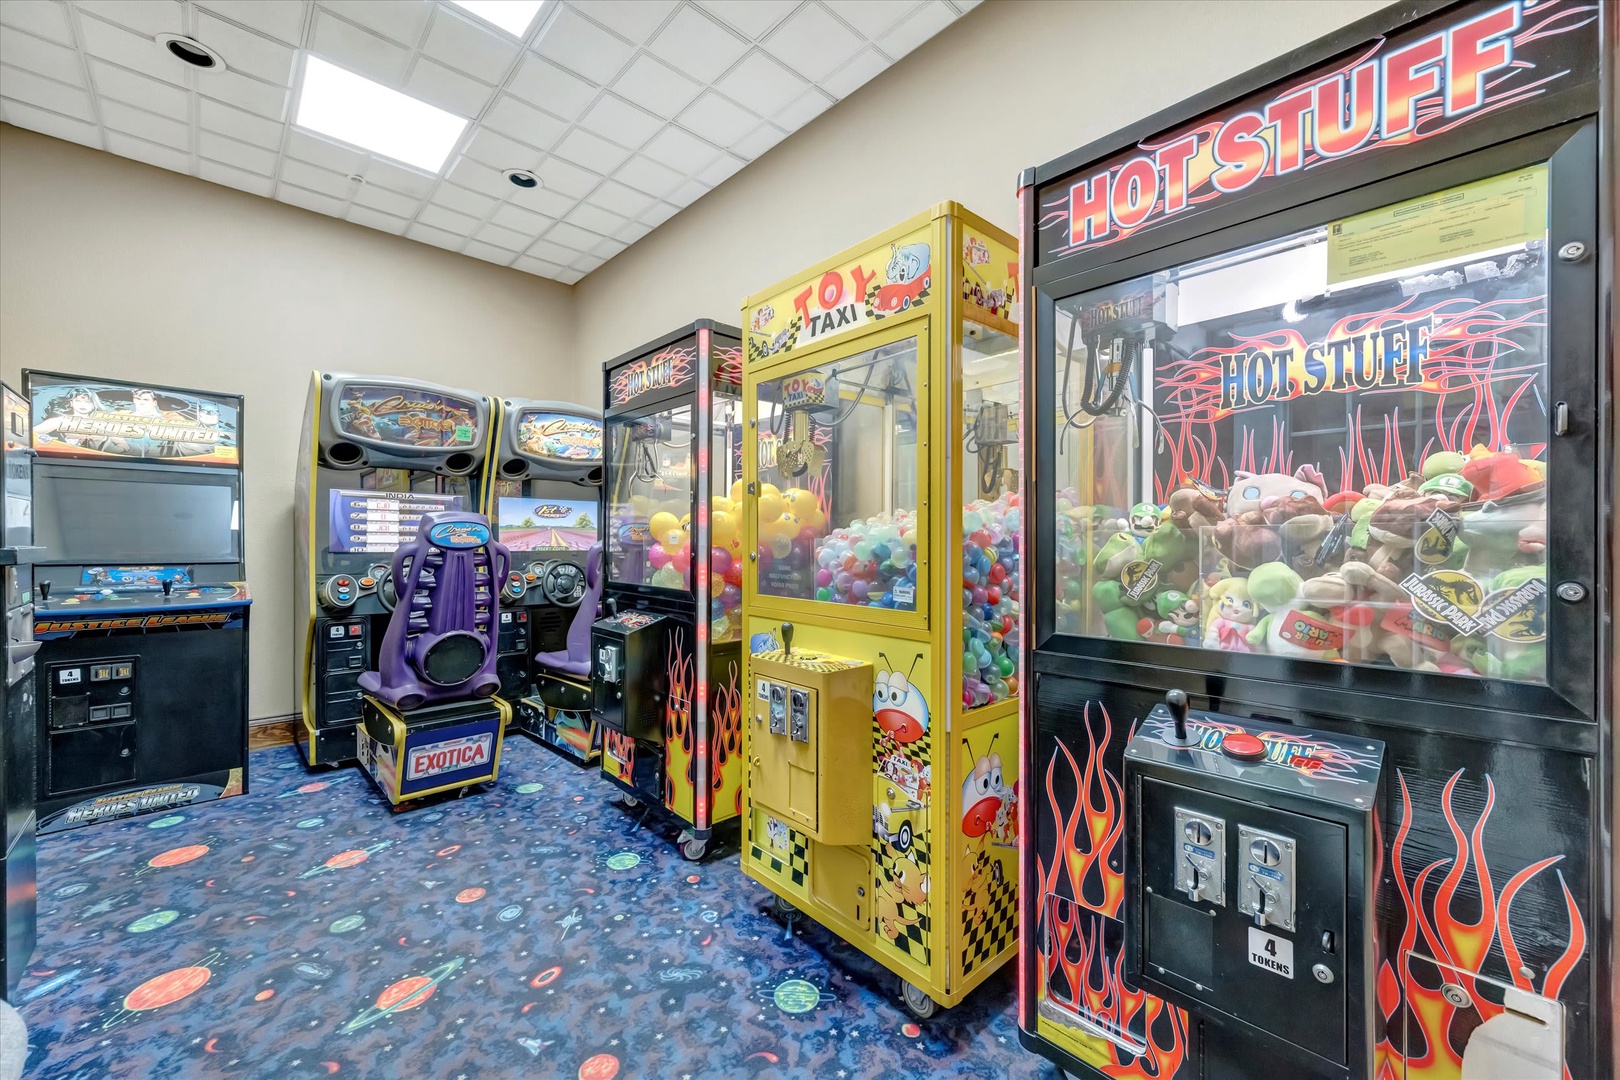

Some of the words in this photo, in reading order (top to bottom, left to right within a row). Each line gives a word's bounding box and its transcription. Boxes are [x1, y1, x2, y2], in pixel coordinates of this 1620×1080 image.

[1066, 134, 1200, 247] HOT
[1211, 2, 1525, 195] STUFF
[793, 264, 877, 329] TOY
[808, 303, 858, 338] TAXI
[1090, 307, 1110, 328] HOT
[1220, 349, 1294, 411] HOT
[1303, 312, 1434, 396] STUFF
[626, 370, 645, 398] HOT
[646, 356, 676, 389] STUFF
[784, 378, 809, 397] TOY
[789, 392, 804, 402] TAXI
[58, 415, 148, 438] HEROES
[148, 424, 220, 444] UNITED
[758, 440, 773, 468] OT
[538, 506, 558, 515] 1st
[1402, 577, 1448, 611] JURASSIC
[1440, 606, 1476, 632] PARK
[34, 618, 146, 633] JUSTICE
[146, 612, 232, 628] LEAGUE
[1294, 620, 1342, 640] MARIO
[762, 683, 766, 692] 4
[414, 744, 484, 774] EXOTICA
[893, 756, 910, 767] TAXI
[65, 799, 140, 825] HEROES
[139, 785, 200, 810] UNITED
[1264, 940, 1277, 957] 4
[1252, 952, 1290, 975] TOKENS
